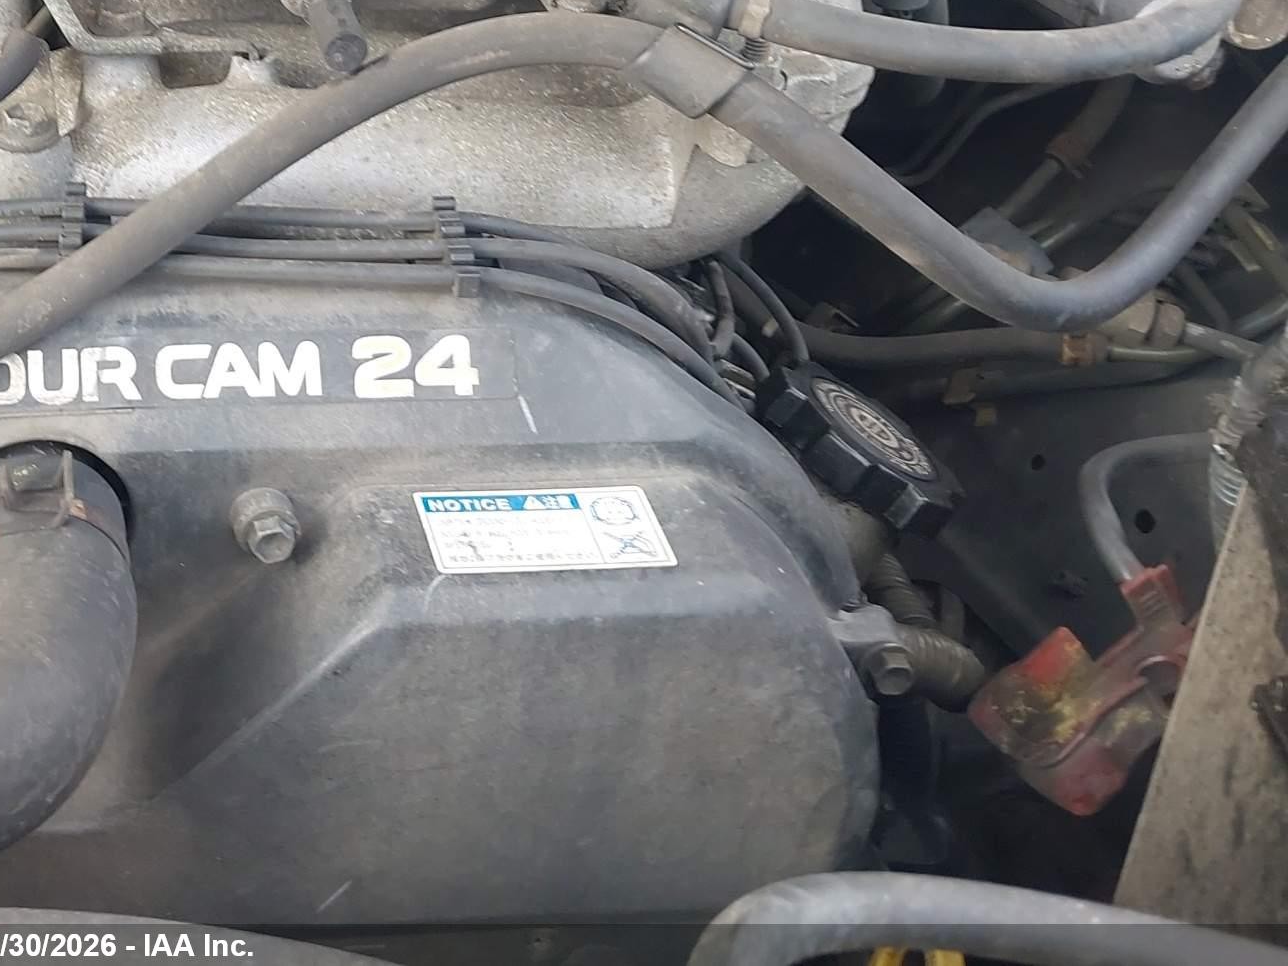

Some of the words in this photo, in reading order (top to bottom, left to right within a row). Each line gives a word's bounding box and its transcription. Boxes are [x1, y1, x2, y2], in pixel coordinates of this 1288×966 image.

[155, 340, 323, 400] CAM
[351, 334, 480, 399] 24
[429, 498, 513, 512] NOTICE
